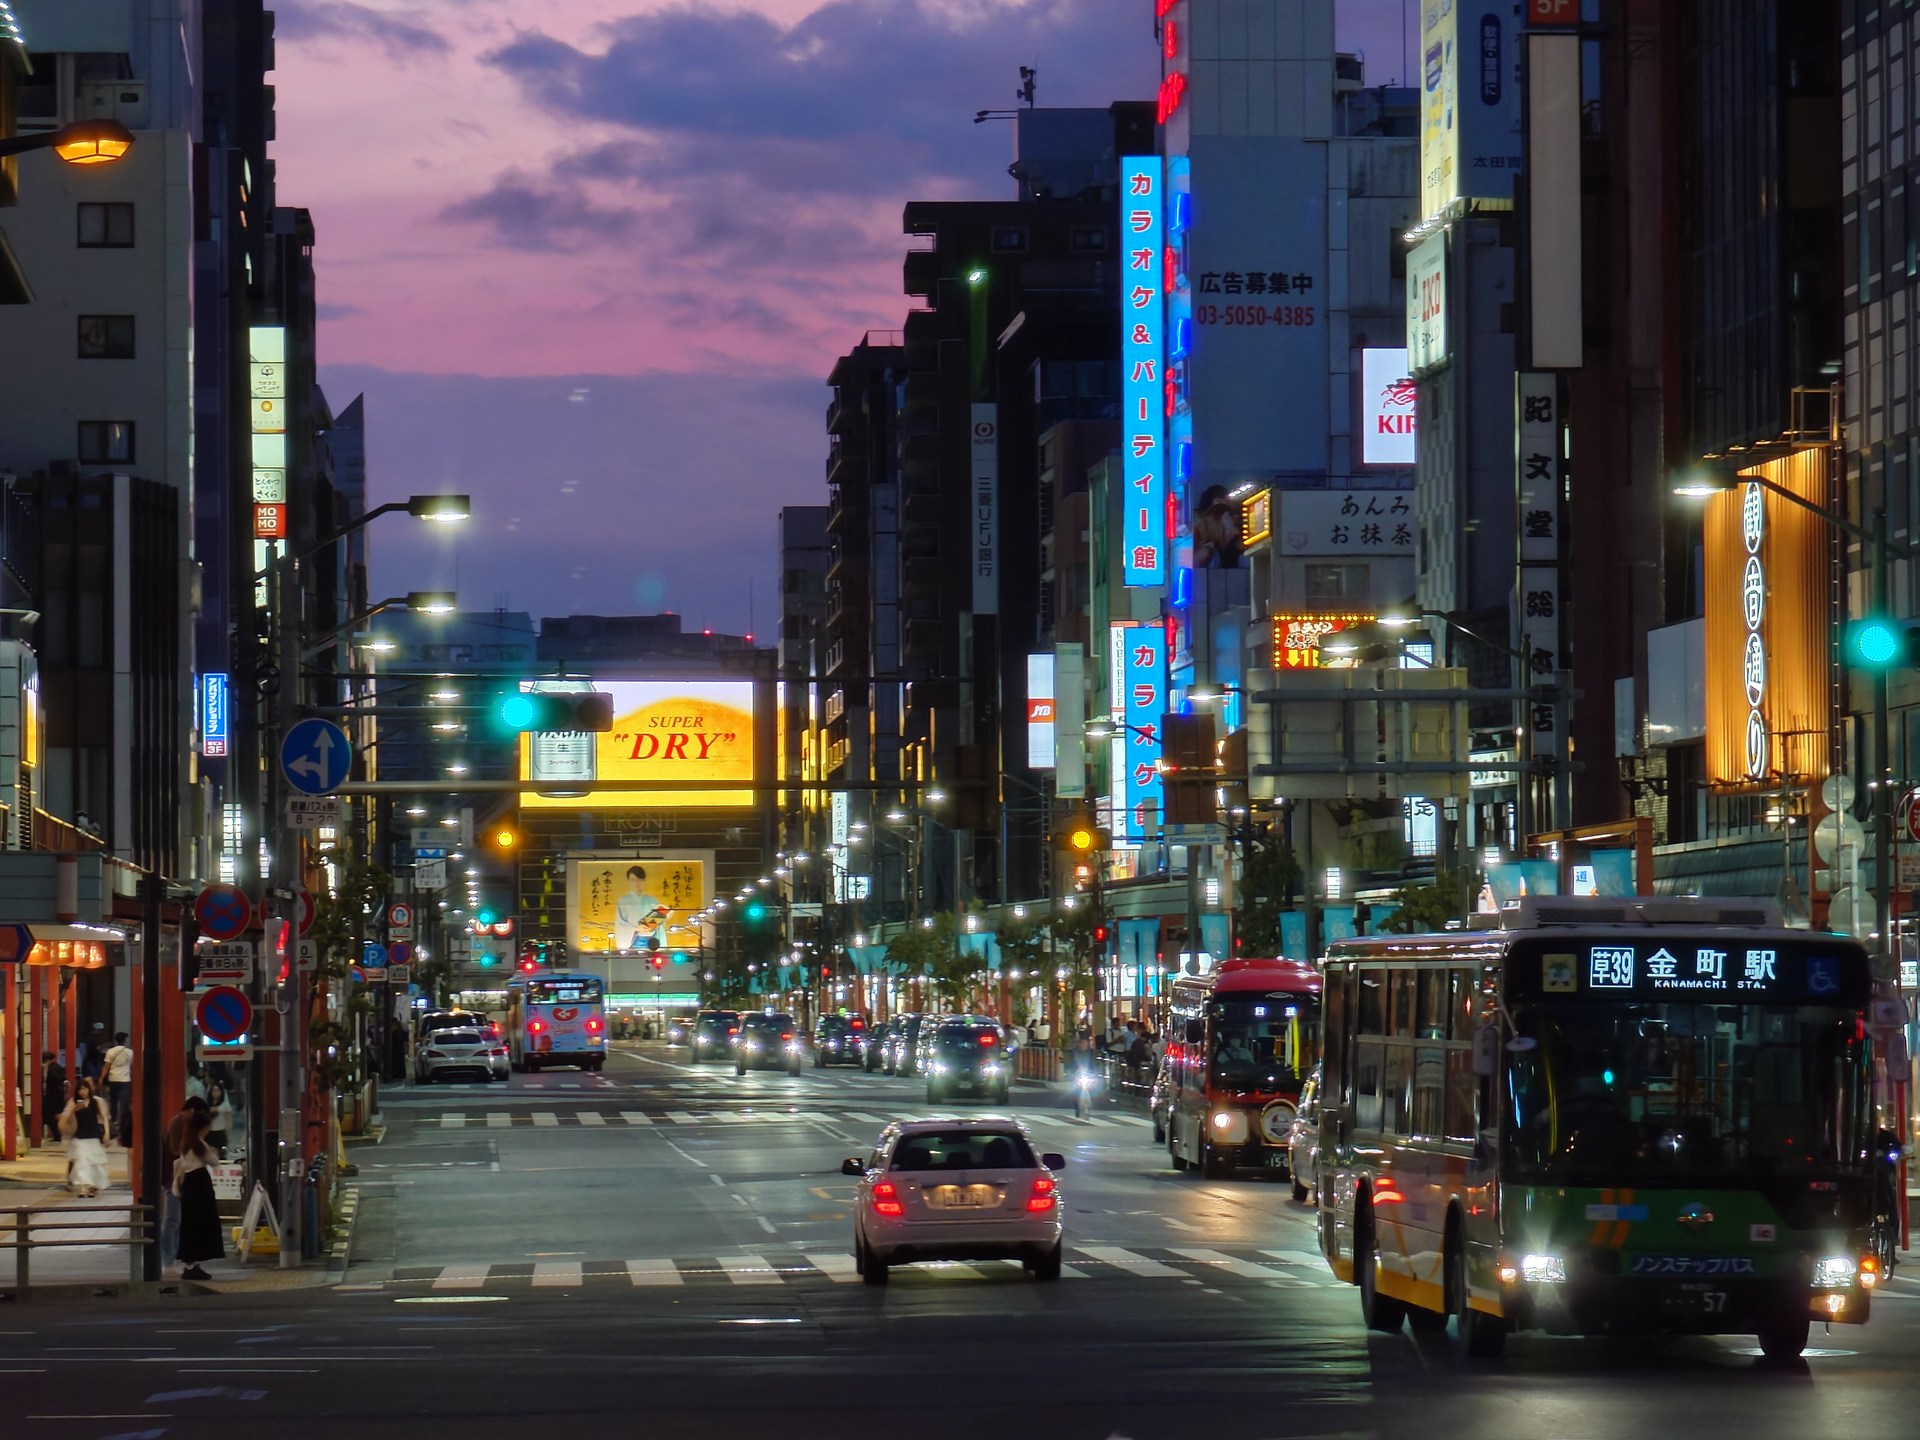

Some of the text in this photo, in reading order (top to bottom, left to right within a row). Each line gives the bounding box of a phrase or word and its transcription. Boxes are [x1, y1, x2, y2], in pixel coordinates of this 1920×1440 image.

[1199, 271, 1313, 295] 広告募集中
[1197, 305, 1314, 326] 03-5050-4385
[1524, 395, 1554, 539] 紀文堂
[257, 507, 277, 516] MO
[257, 519, 277, 528] MO
[977, 476, 992, 578] 三菱UFJ銀行
[1331, 522, 1412, 546] お抹茶
[1031, 705, 1051, 718] JTB
[648, 716, 704, 728] SUPER
[207, 746, 223, 754] 3F
[557, 742, 570, 753] 生
[1593, 948, 1776, 984] 草39 金町駅
[1654, 979, 1767, 990] KANAMACHI STA.
[1632, 1257, 1755, 1274] ノンステップバス
[1703, 1292, 1727, 1312] 57
